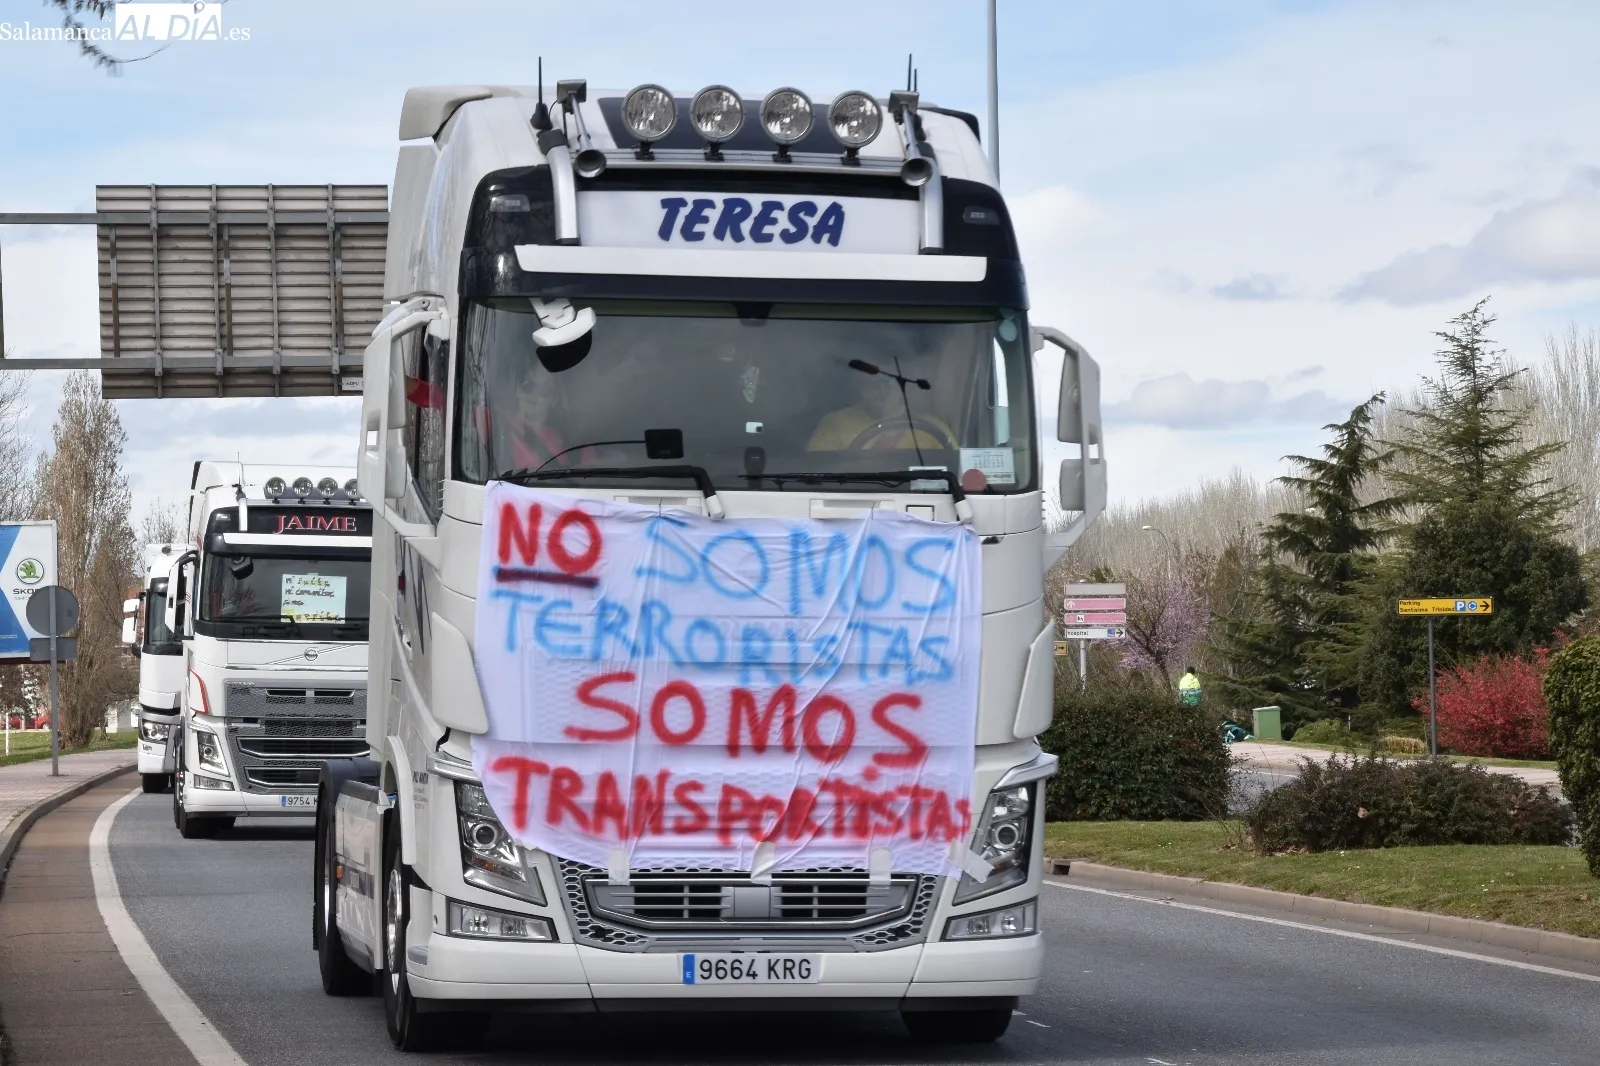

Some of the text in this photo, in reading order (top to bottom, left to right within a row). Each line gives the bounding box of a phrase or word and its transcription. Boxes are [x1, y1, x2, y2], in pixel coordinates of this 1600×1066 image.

[658, 197, 846, 248] TERESA
[273, 514, 357, 535] JAIME
[497, 501, 957, 617] NO SOMOS
[489, 588, 955, 686] TERRORISTAS
[565, 672, 928, 769] SOMOS
[287, 796, 310, 806] 9754
[492, 756, 972, 846] TRANSPORTISTAS
[699, 958, 759, 981] 9664
[767, 958, 812, 981] KRG
